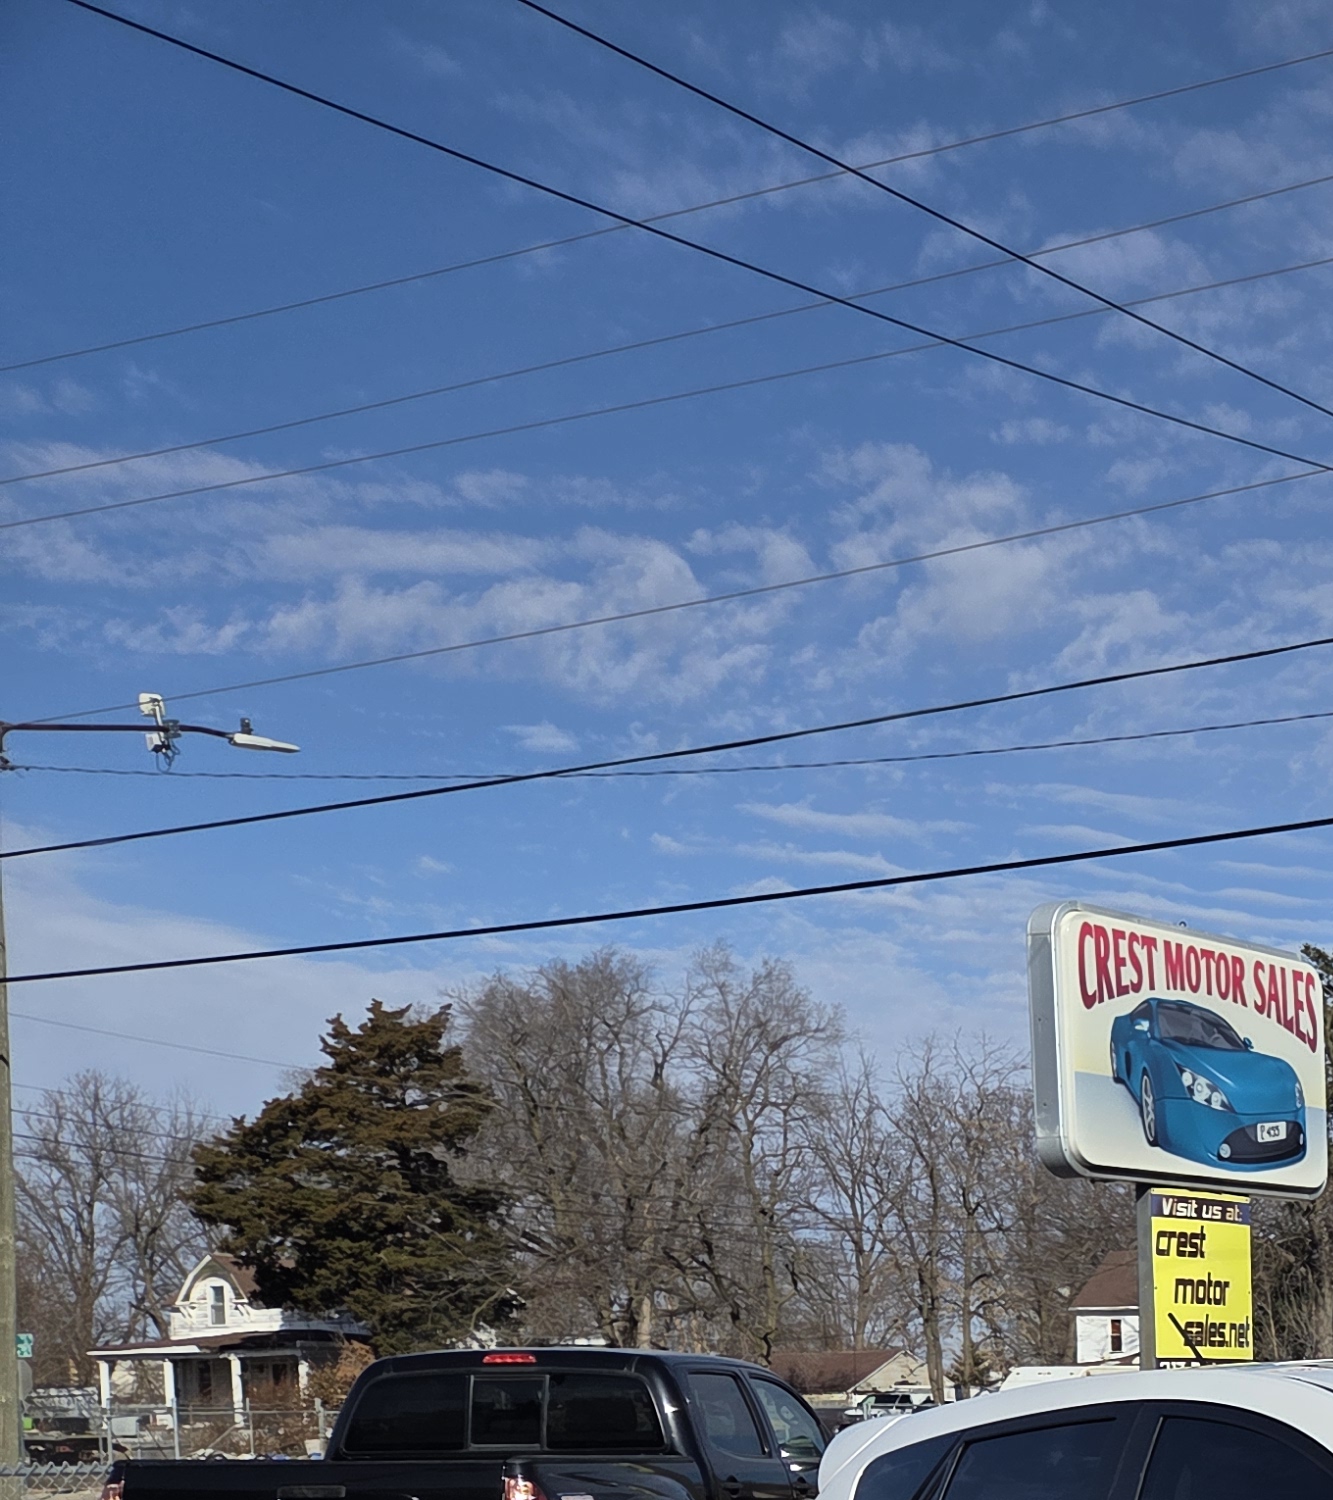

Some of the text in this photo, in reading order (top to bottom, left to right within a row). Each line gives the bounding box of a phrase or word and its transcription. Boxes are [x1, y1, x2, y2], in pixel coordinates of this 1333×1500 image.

[1078, 921, 1317, 1054] CREST MOTOR SALES
[1162, 1197, 1198, 1217] Visit
[1202, 1204, 1222, 1220] us
[1156, 1225, 1206, 1258] crest
[1174, 1272, 1230, 1306] motor
[1183, 1313, 1250, 1348] sales.net
